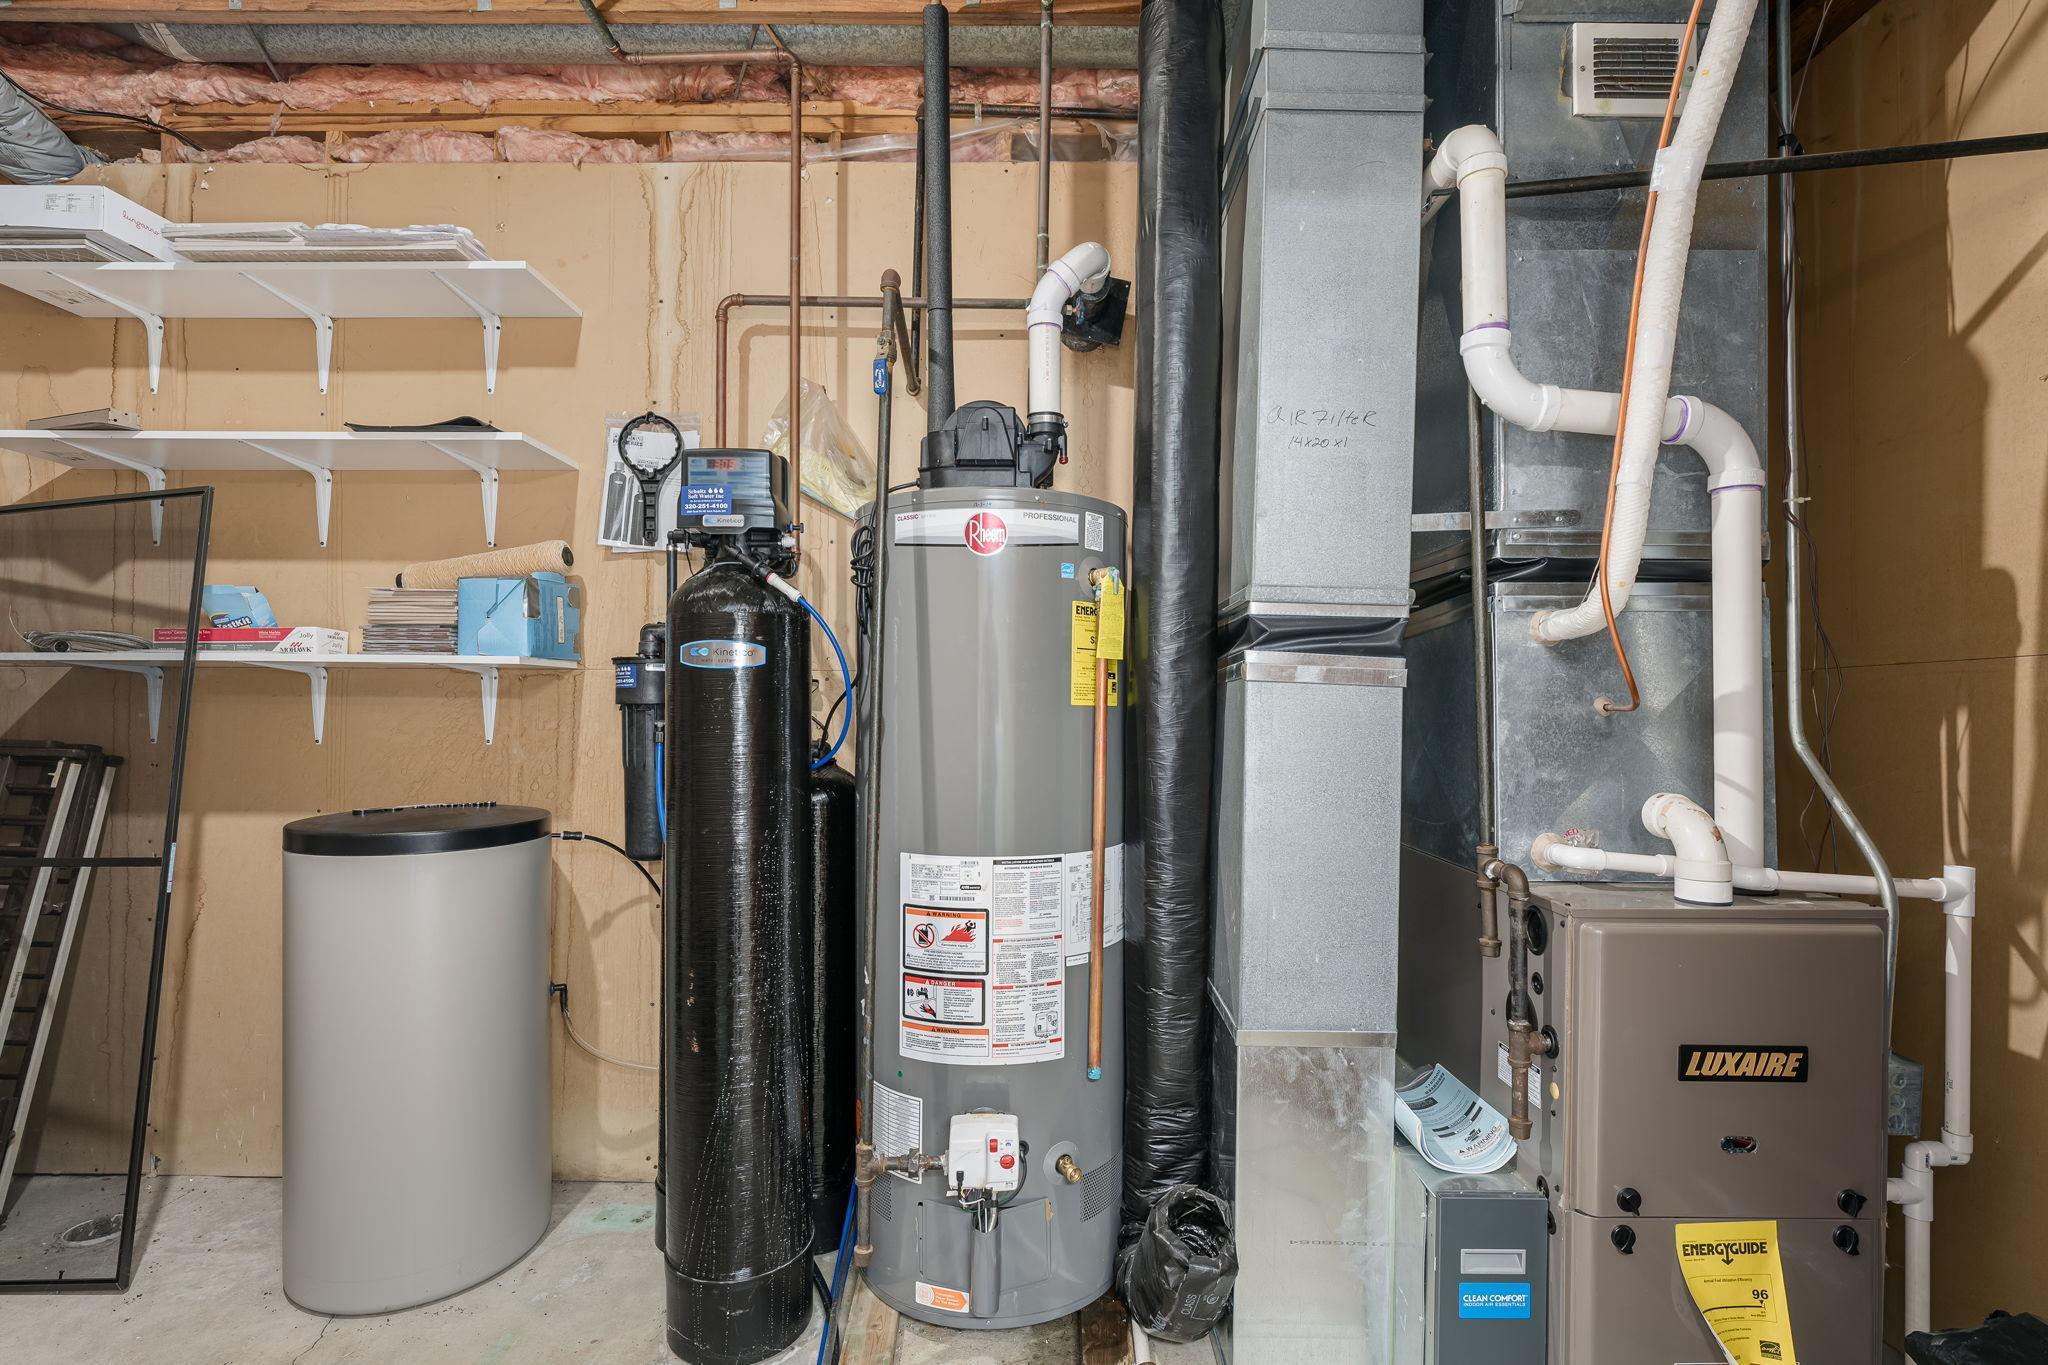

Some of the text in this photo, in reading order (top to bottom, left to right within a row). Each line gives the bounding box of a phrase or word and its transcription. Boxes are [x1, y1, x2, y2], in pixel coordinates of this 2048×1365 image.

[1023, 511, 1077, 523] PROFESSIONAL
[969, 511, 1006, 548] Rheem
[299, 632, 314, 640] Jolly
[1685, 1051, 1804, 1077] LUXAIRE
[1465, 1125, 1499, 1151] WARNING
[1682, 1242, 1768, 1260] ENERGYGUIDE
[1463, 1294, 1526, 1302] CLEAN COMFORT
[1752, 1289, 1769, 1300] 96
